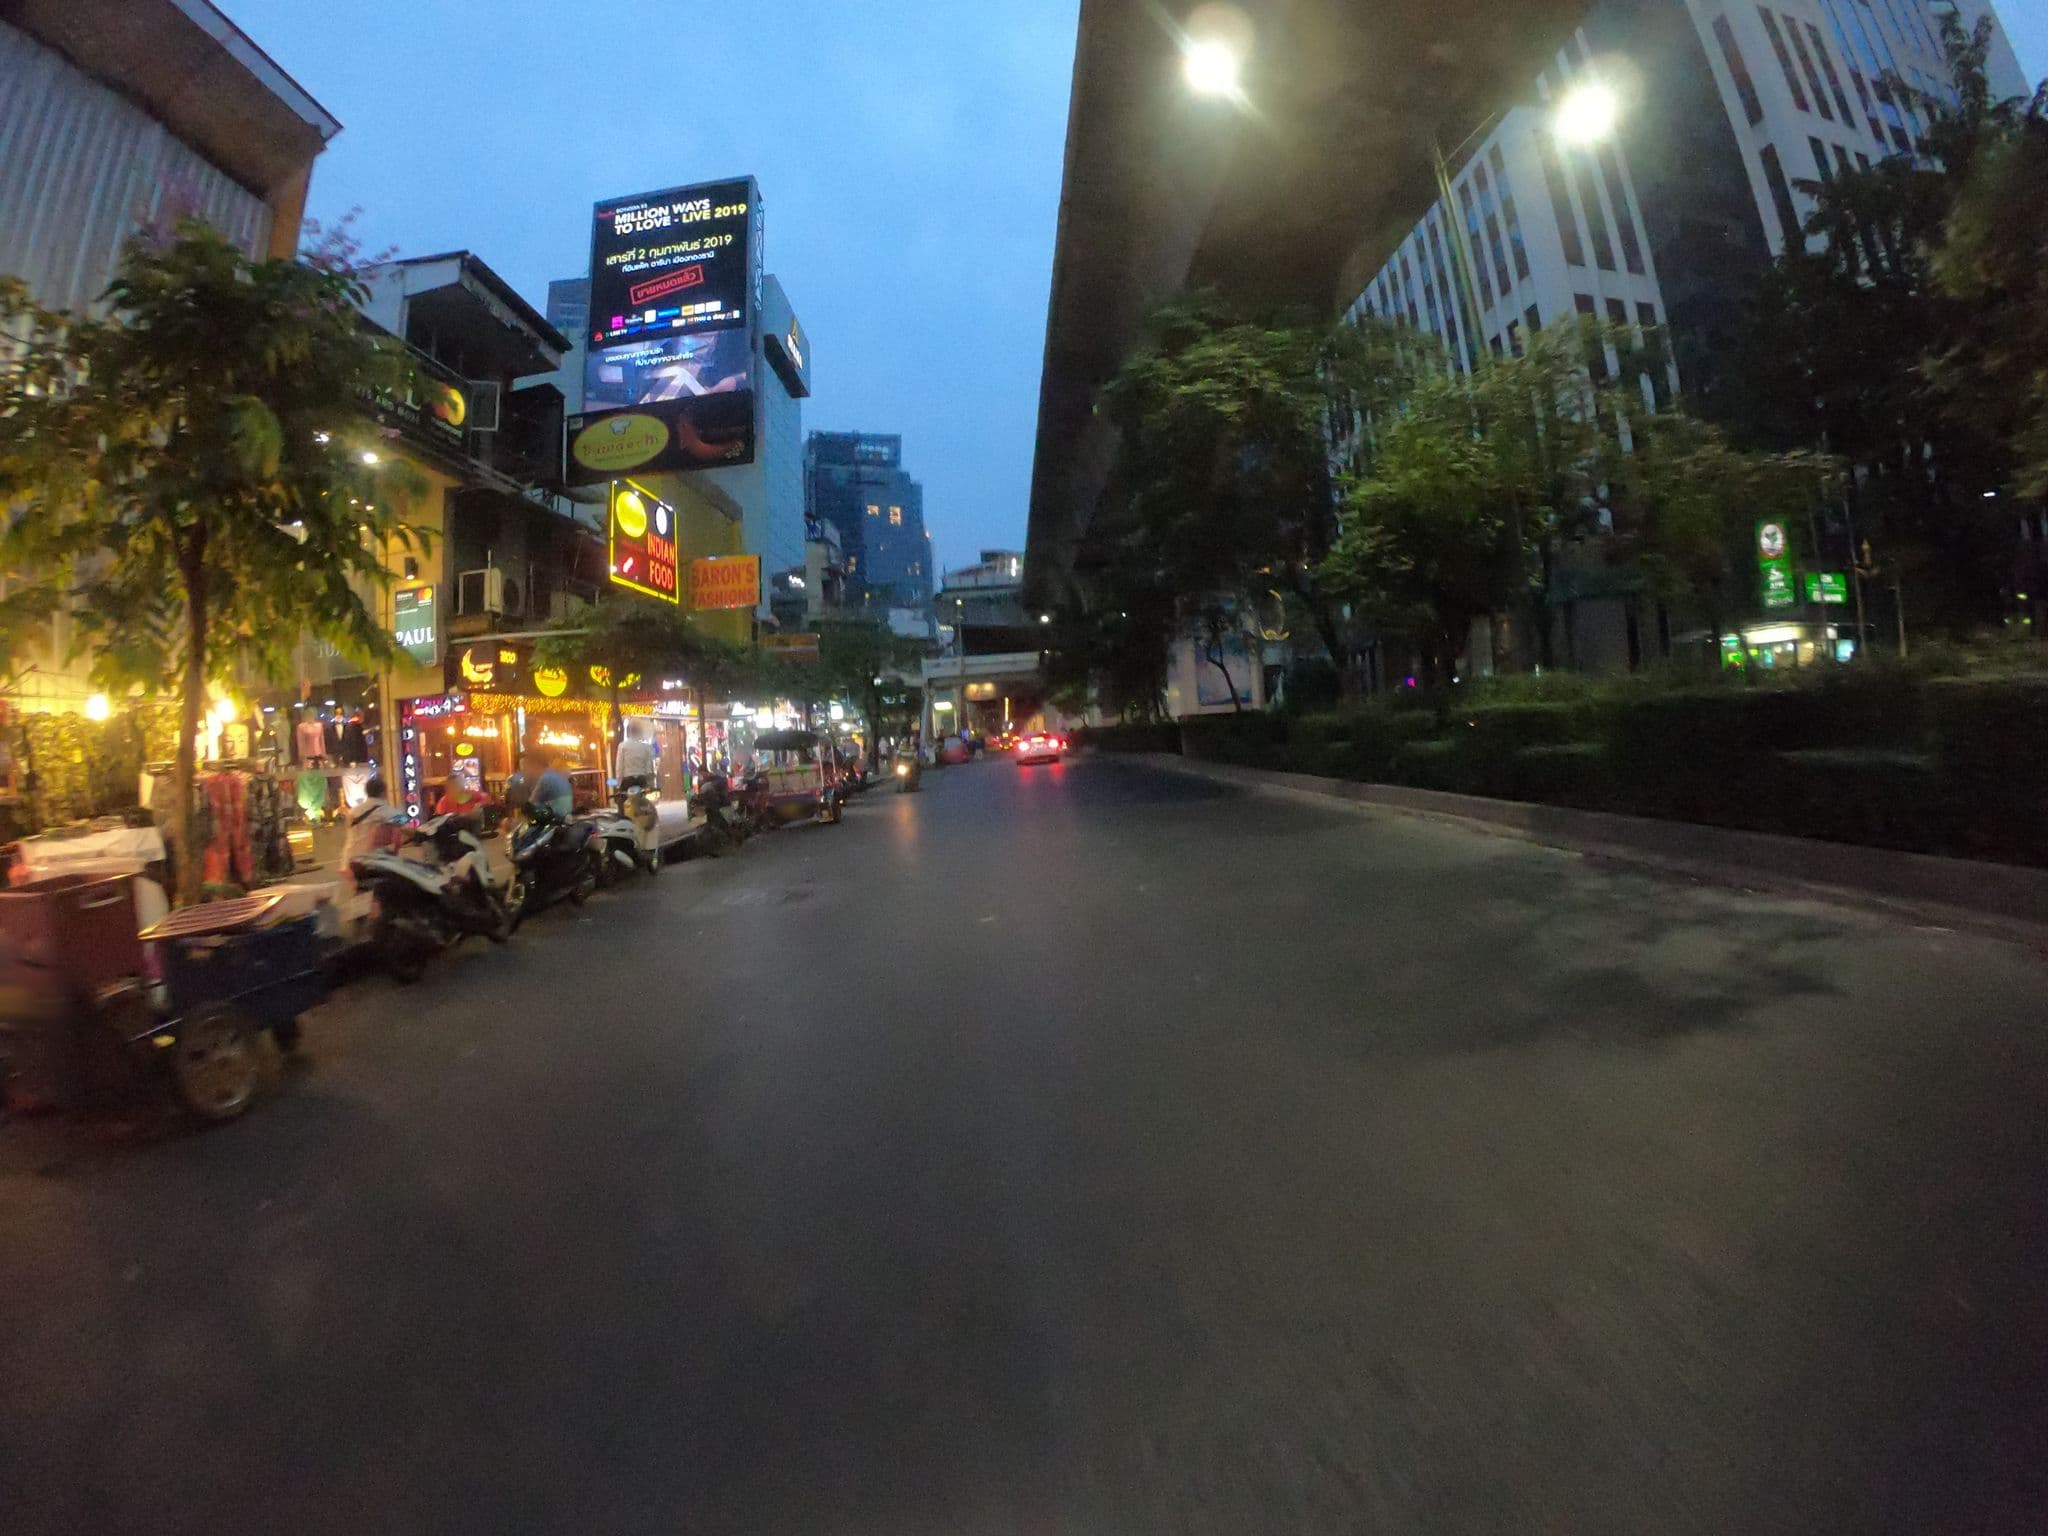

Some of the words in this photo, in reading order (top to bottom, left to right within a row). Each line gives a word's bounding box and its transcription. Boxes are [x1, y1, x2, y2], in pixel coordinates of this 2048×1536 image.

[615, 205, 669, 225] MILLION
[672, 199, 710, 214] WAYS
[615, 223, 633, 235] TO
[636, 216, 671, 232] LOVE
[682, 209, 711, 223] LIVE
[714, 203, 747, 218] 2019
[638, 249, 645, 260] 2
[703, 234, 733, 250] 2019
[648, 532, 675, 566] INDIAN
[650, 560, 673, 591] FOOD
[692, 562, 755, 588] BARON'S
[395, 626, 435, 647] PAUL
